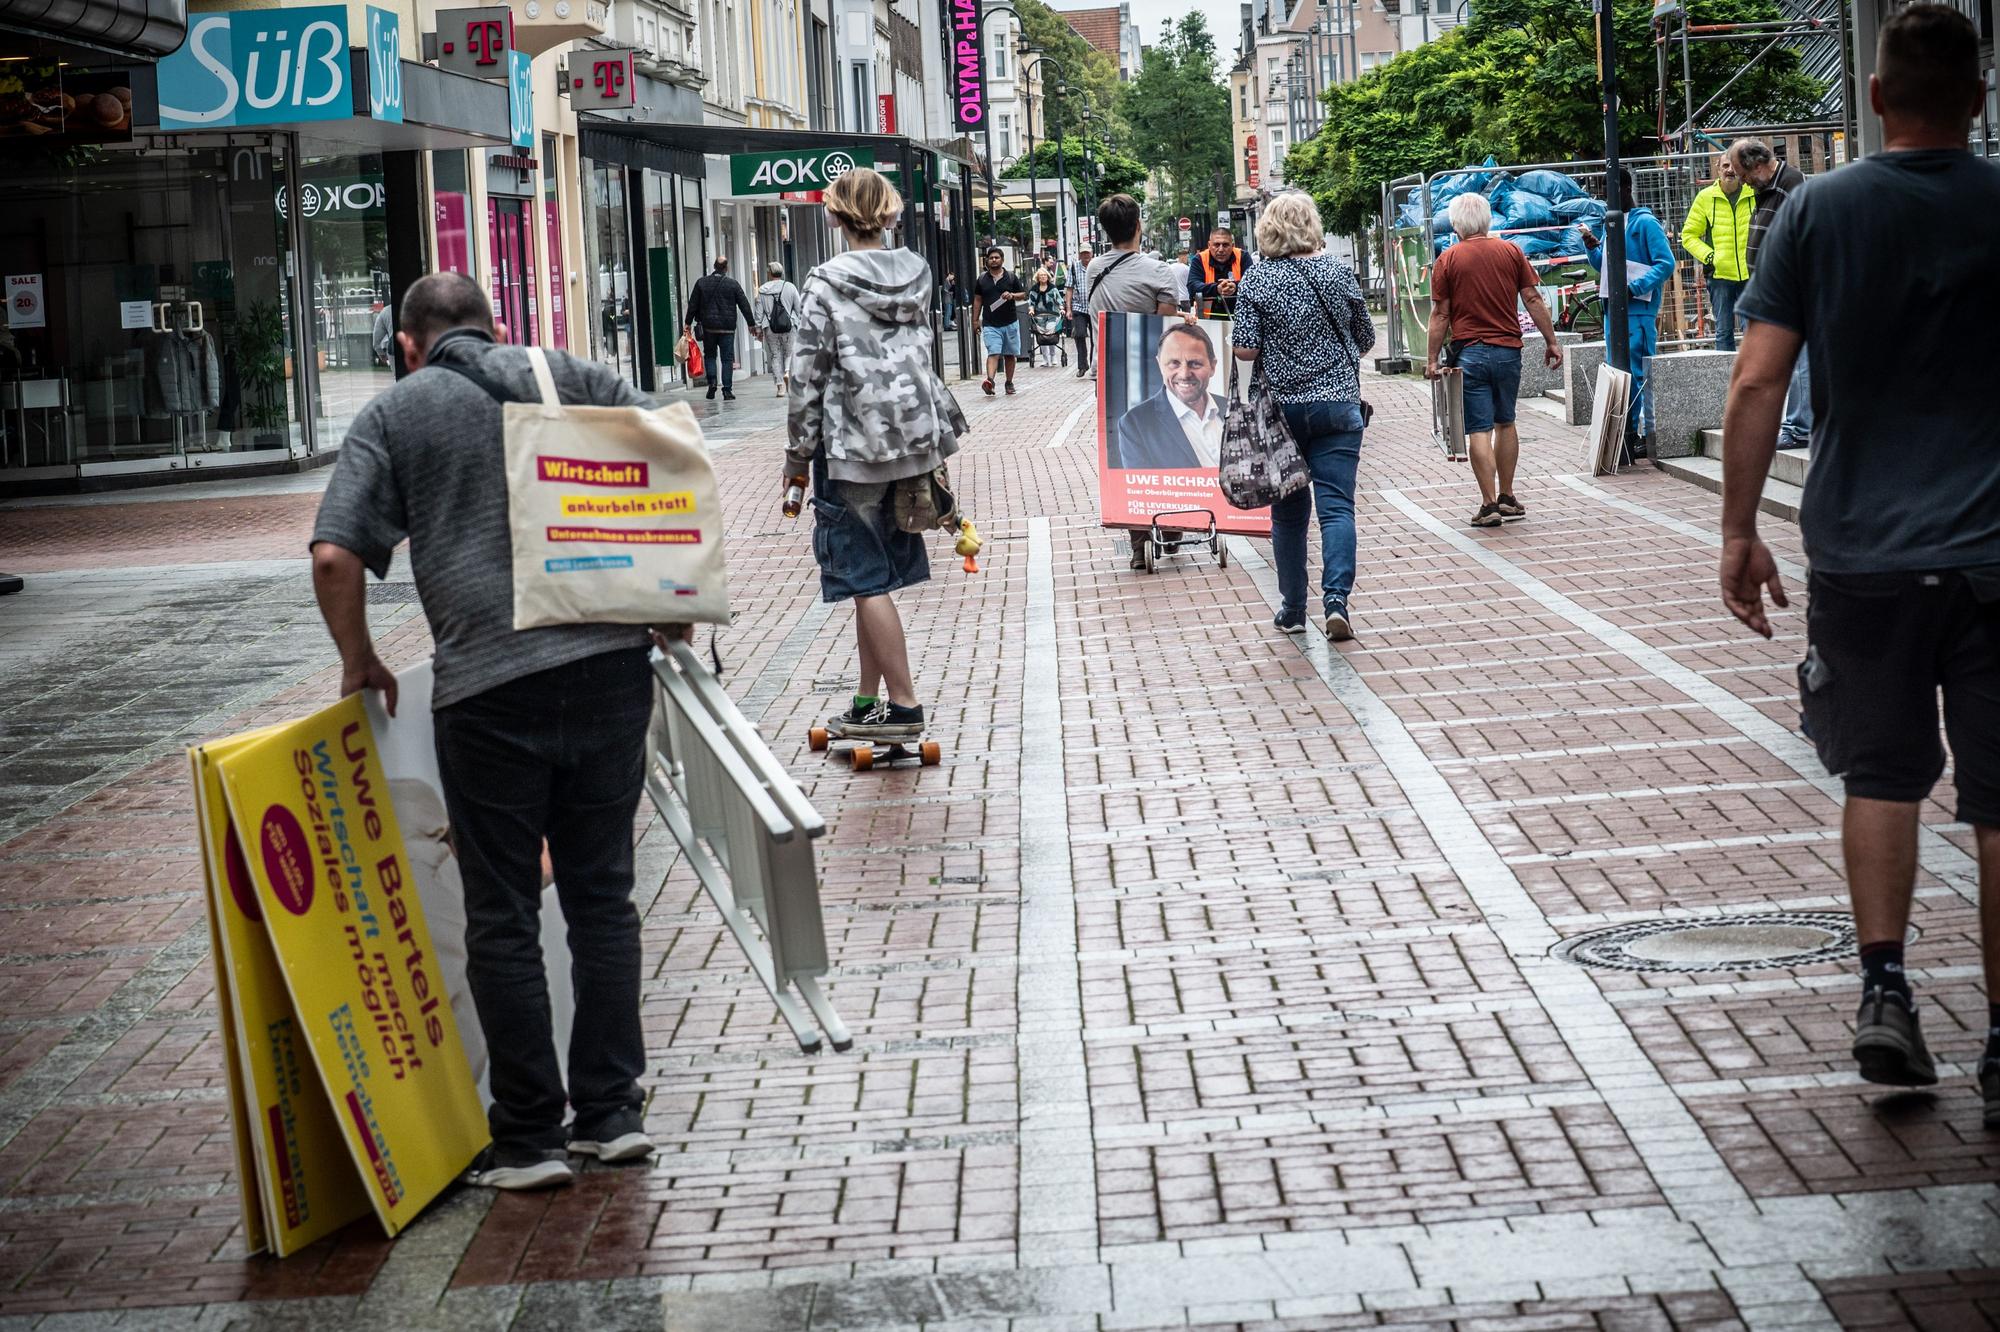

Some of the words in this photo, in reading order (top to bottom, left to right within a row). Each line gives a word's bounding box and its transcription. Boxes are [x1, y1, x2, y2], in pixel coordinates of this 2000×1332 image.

[966, 31, 977, 40] &
[159, 17, 343, 123] Süß
[371, 11, 400, 114] Süß
[957, 41, 982, 123] OLYMP
[512, 54, 533, 141] Süß
[749, 157, 820, 187] AOK
[11, 276, 37, 285] SALE
[544, 460, 641, 483] Wirtschaft
[1125, 474, 1160, 486] UWE
[1144, 488, 1214, 498] Oberbürgermeister
[567, 499, 646, 513] ankurbeln
[651, 497, 687, 510] statt
[1127, 500, 1145, 508] FÜR
[1146, 502, 1200, 511] LEVERKUSEN
[550, 529, 625, 541] Unternehmen
[312, 739, 380, 937] Wirtschaft
[373, 952, 423, 1070] macht
[341, 721, 382, 842] Uwe
[376, 855, 443, 1048] Bartels
[294, 748, 350, 914] Soziales
[344, 924, 405, 1080] möglich
[338, 1002, 370, 1078] Freie
[328, 1009, 406, 1199] Demokraten
